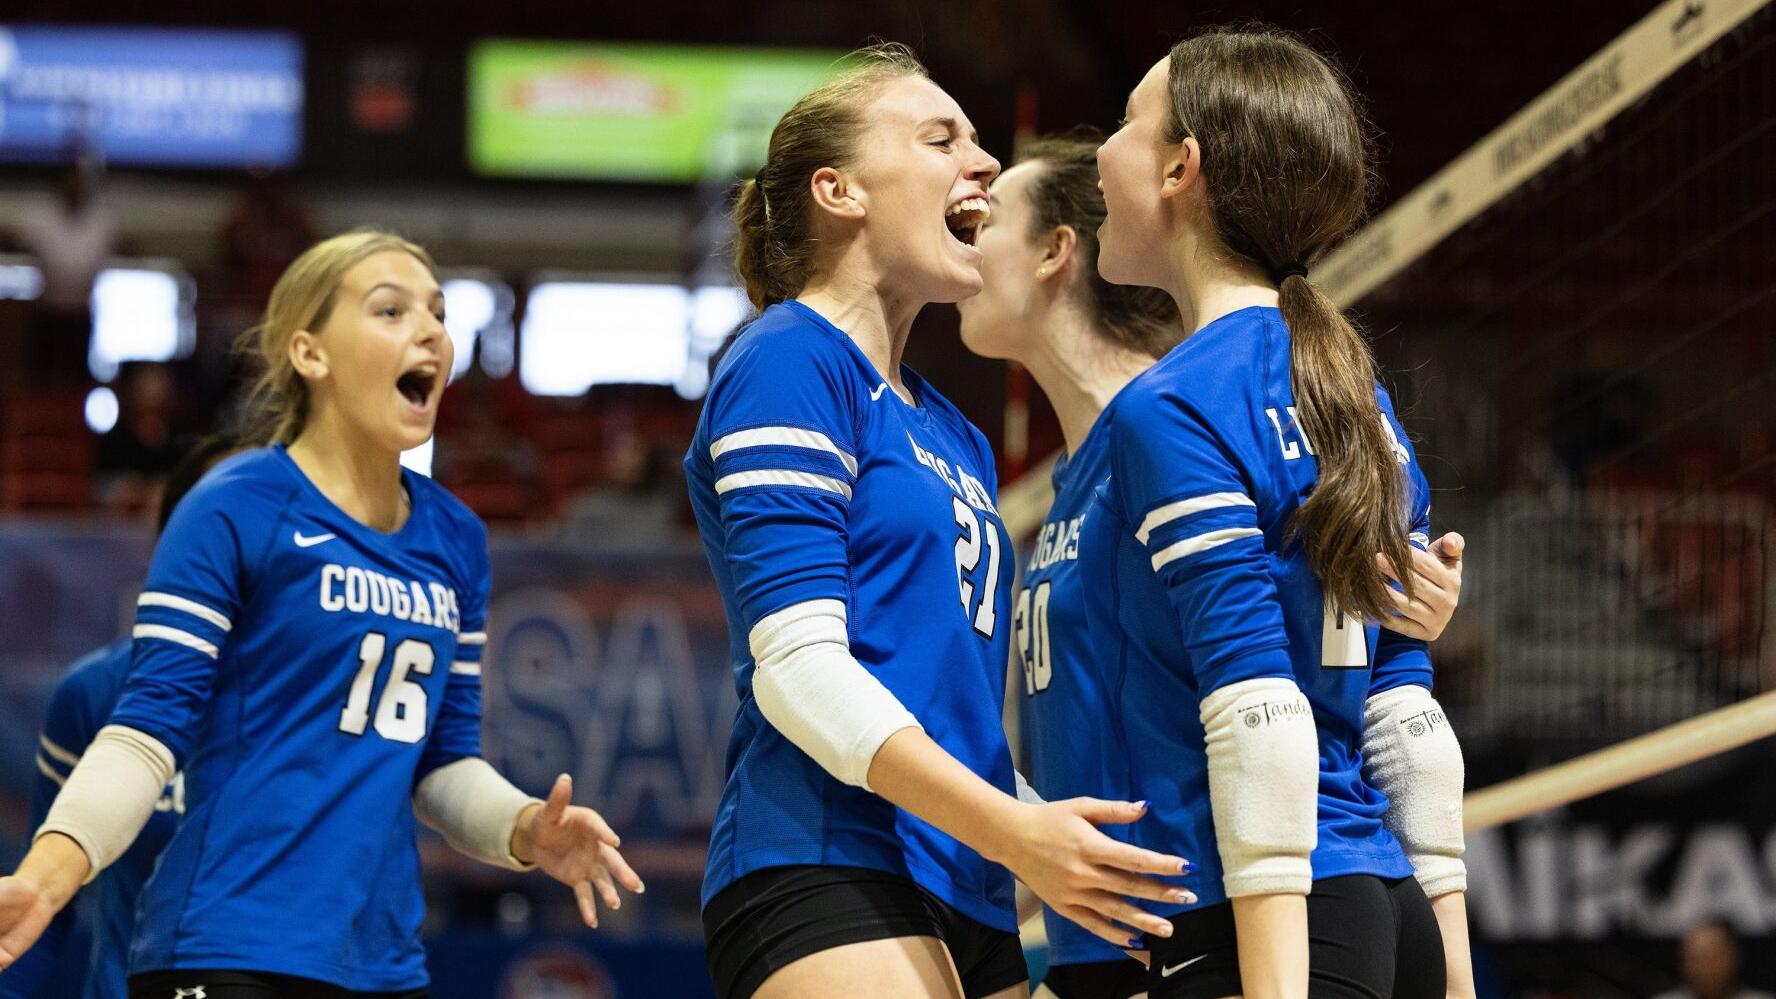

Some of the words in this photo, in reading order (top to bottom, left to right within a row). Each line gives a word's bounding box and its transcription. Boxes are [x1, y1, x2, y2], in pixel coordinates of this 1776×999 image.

[951, 493, 1001, 640] 21
[338, 630, 436, 745] 16
[1015, 580, 1052, 695] 20
